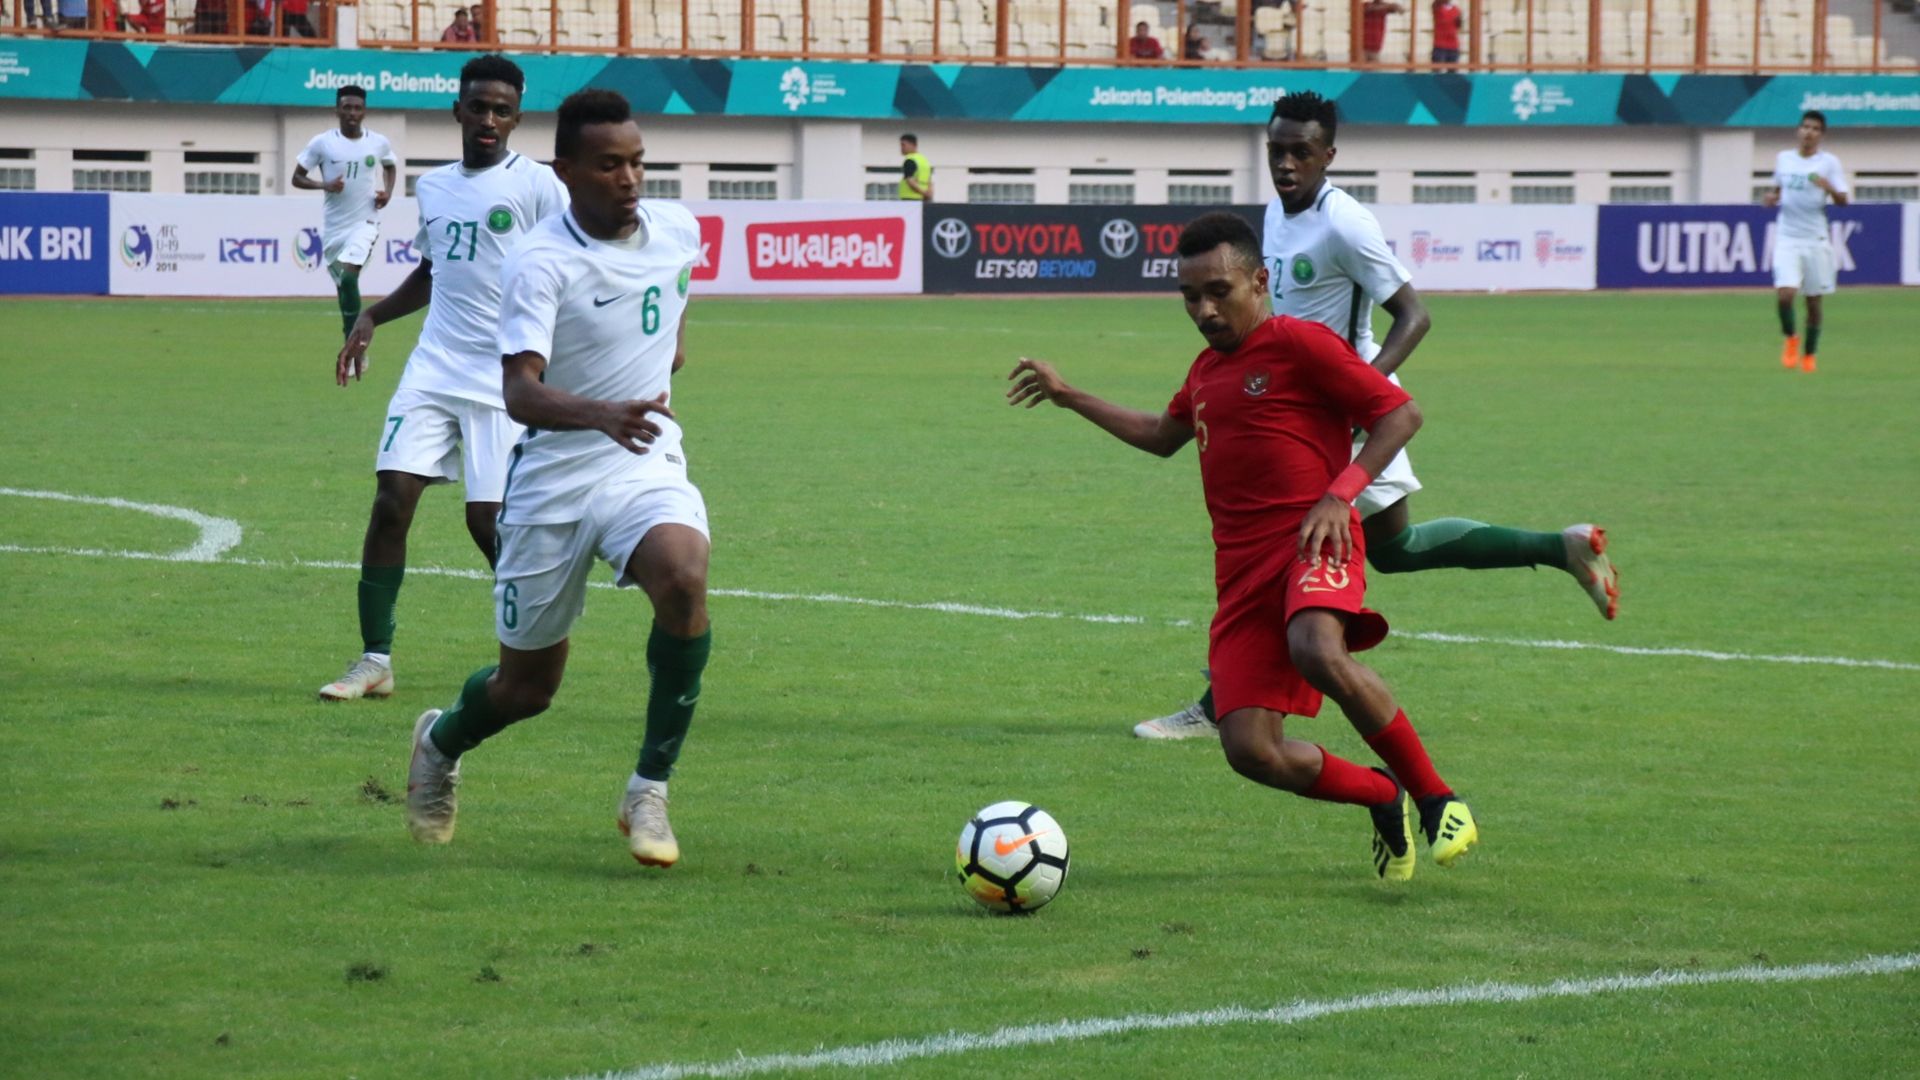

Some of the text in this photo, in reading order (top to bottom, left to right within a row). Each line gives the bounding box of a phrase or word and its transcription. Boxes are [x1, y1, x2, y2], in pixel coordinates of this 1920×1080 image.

[304, 68, 460, 93] Jakarta Palemba
[1090, 86, 1152, 105] Jakarta
[1155, 86, 1247, 111] Palembang
[346, 161, 359, 180] 11
[40, 227, 92, 261] BRI
[156, 224, 178, 239] AFC
[446, 221, 479, 262] 27
[974, 224, 1084, 255] TOYOTA
[156, 239, 179, 252] U-19
[219, 238, 279, 263] RCTI
[1477, 240, 1521, 262] RCTI
[1637, 222, 1757, 273] ULTRA
[156, 262, 178, 272] 2018
[1038, 259, 1097, 278] BEYOND
[1273, 257, 1284, 300] 2
[642, 285, 662, 336] 6
[383, 416, 405, 452] 7
[502, 582, 518, 630] 6
